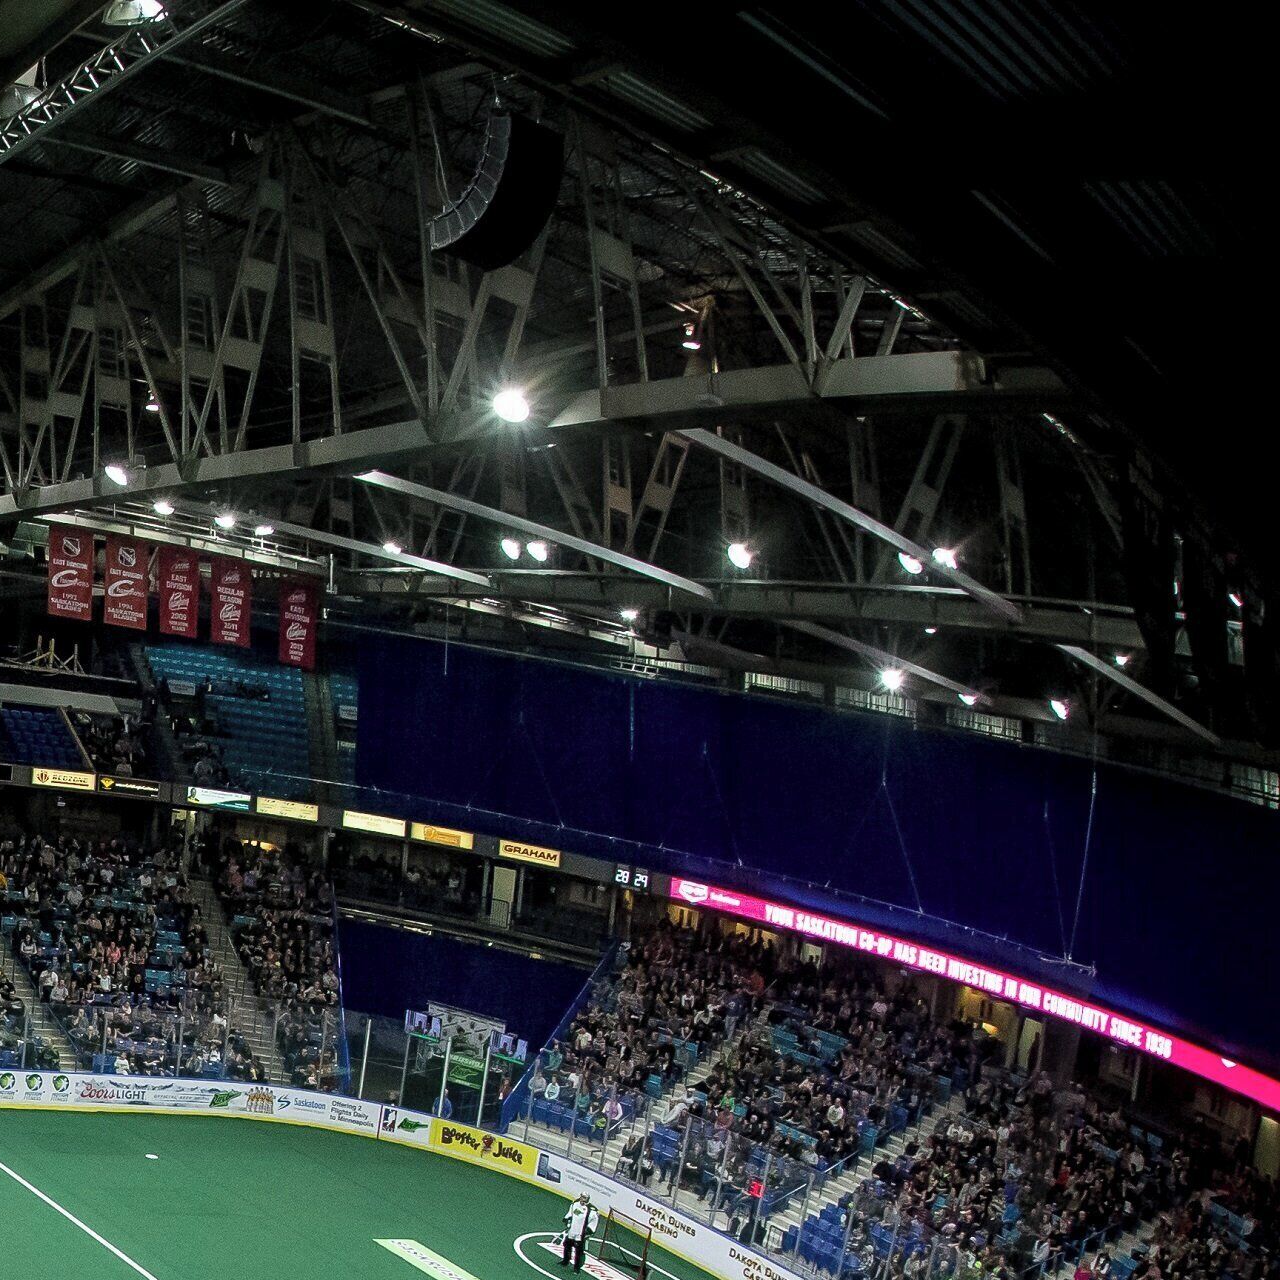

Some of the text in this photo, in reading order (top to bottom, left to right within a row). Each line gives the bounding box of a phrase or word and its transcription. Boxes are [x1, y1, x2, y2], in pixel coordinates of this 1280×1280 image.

[171, 574, 187, 583] EAST
[166, 581, 192, 592] DIVISION
[217, 586, 244, 598] REGULAR
[290, 605, 305, 614] EAST
[504, 844, 558, 862] GRAHAM
[615, 869, 648, 888] 28 29
[765, 904, 794, 929] YOUR
[796, 913, 858, 947] SASKATOON
[859, 930, 892, 958] CO-OP
[894, 942, 917, 965] HAS
[948, 959, 1003, 994] INVESTING
[1043, 993, 1109, 1032] COMMUNITY
[1110, 1018, 1143, 1046] SINCE
[80, 1084, 115, 1100] Coors
[116, 1089, 146, 1100] LIGHT
[294, 1097, 326, 1110] Saskatoon
[331, 1100, 355, 1111] Offering
[330, 1107, 369, 1120] Flights Daily
[337, 1115, 374, 1128] Minneapolis
[441, 1127, 523, 1165] Booster Juice
[635, 1199, 696, 1237] DAKOTA DUNES
[648, 1217, 679, 1239] CASINO
[728, 1247, 762, 1274] DAKOTA
